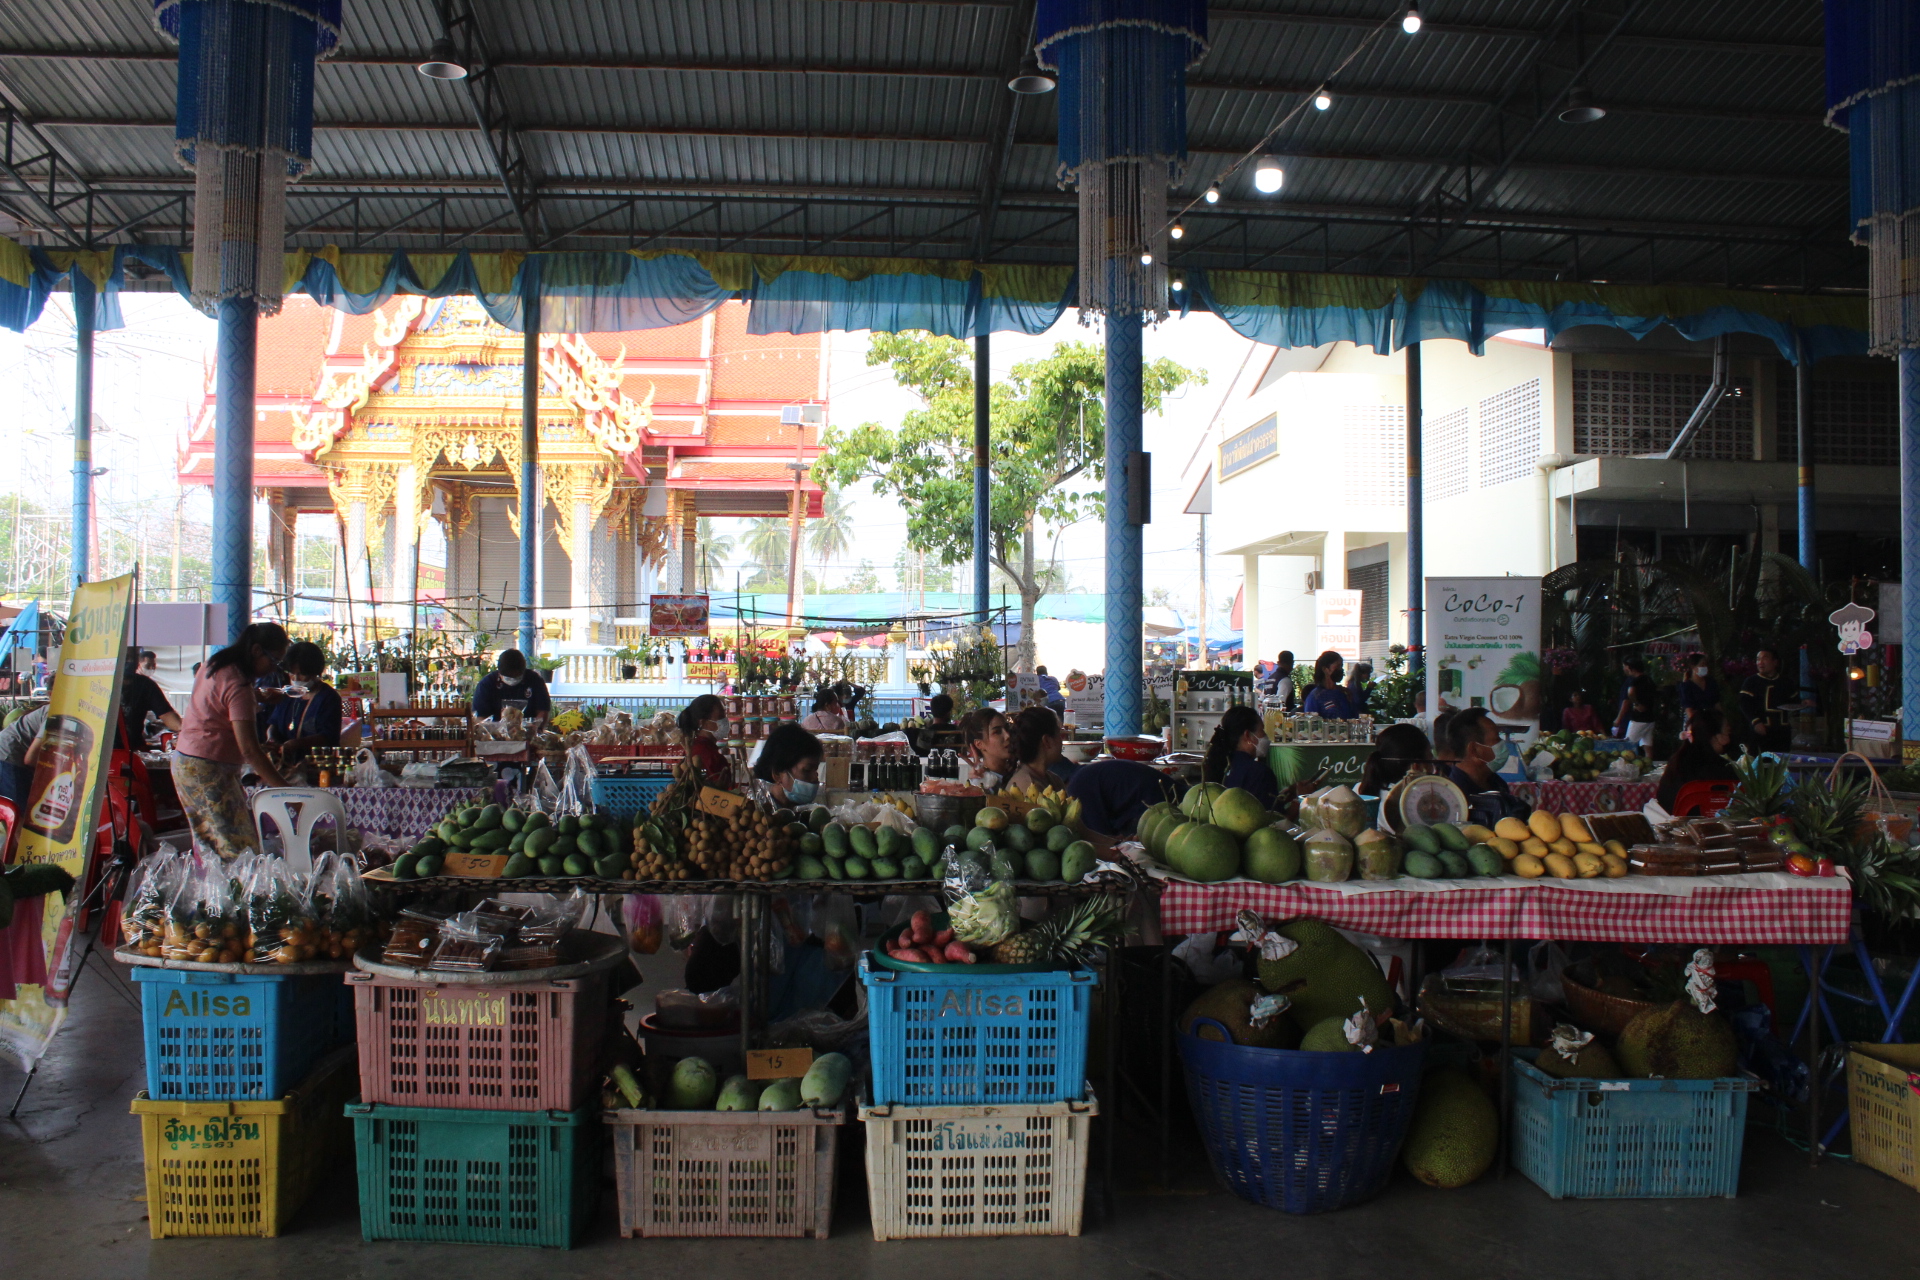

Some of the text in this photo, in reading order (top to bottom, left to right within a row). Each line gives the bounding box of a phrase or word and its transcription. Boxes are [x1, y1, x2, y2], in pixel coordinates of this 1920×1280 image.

[1320, 629, 1357, 643] ห้องน้ำ
[1459, 634, 1475, 642] Virgin
[710, 795, 730, 809] 50
[467, 858, 491, 870] 50
[163, 989, 251, 1017] Alisa
[422, 989, 506, 1027] นันทนัช
[938, 988, 1024, 1017] Alisa
[766, 1055, 784, 1069] 15
[190, 1141, 235, 1149] 2563
